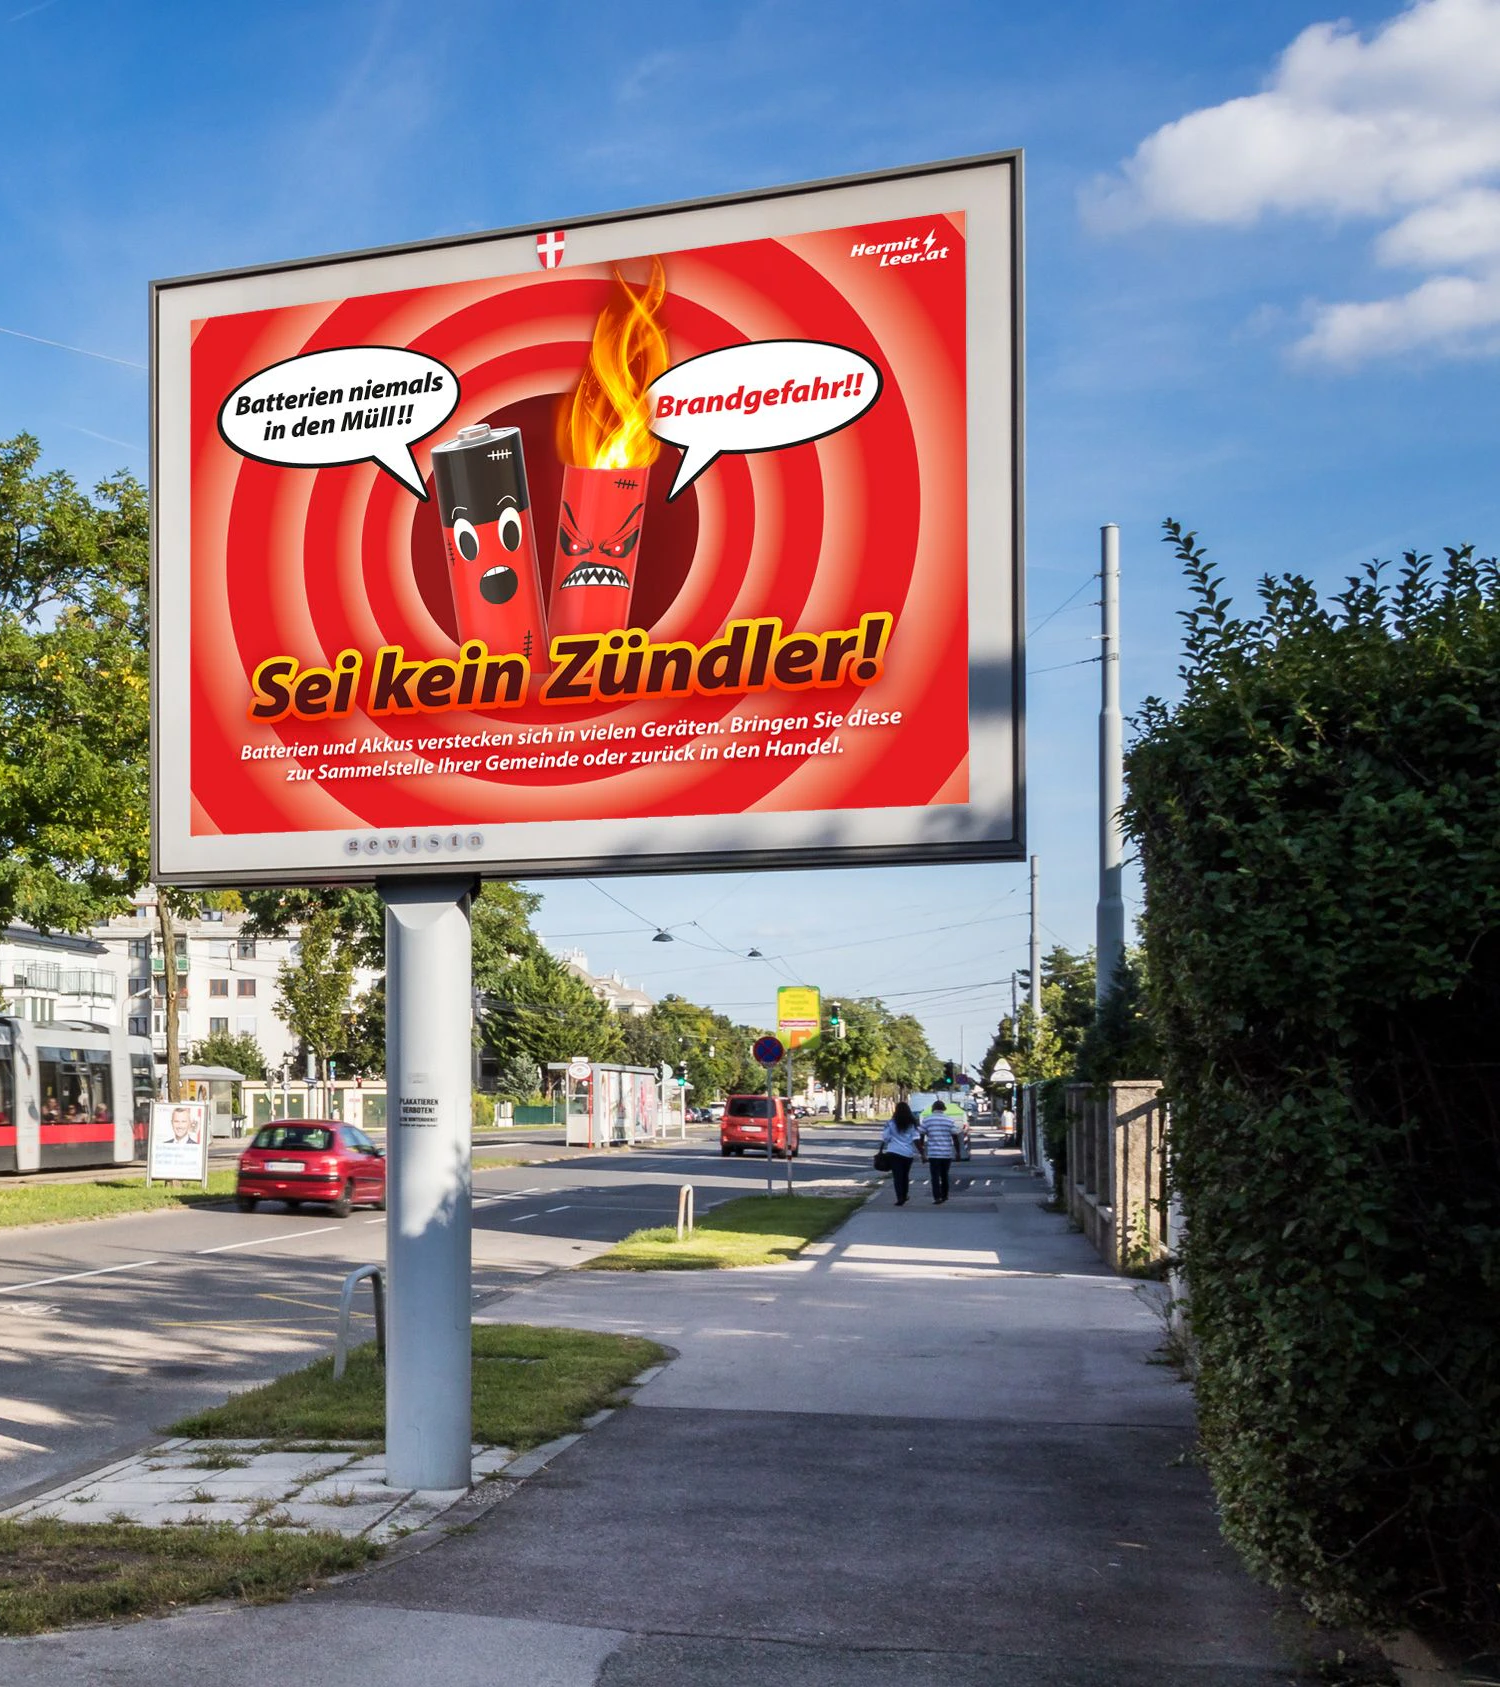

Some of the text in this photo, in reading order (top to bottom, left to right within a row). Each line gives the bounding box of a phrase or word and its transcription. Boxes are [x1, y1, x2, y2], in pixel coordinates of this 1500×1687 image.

[850, 236, 920, 257] Hermit
[880, 246, 949, 267] Leer.at
[235, 371, 443, 416] Batterien niemals
[655, 372, 865, 415] Brandgefahr!!
[263, 404, 414, 441] in den Müll!!
[251, 616, 888, 719] Sei kein Zündler!
[240, 708, 903, 761] Batterien und Akkus verstecken sich in vielen Geräten. Bringen Sie diese
[285, 736, 845, 782] zur Sammelstelle Ihrer Gemeinde oder zurück in den Handel.
[347, 832, 482, 854] gewista
[399, 1098, 439, 1106] PLAKATIEREN
[402, 1106, 436, 1114] VERBOTEN!
